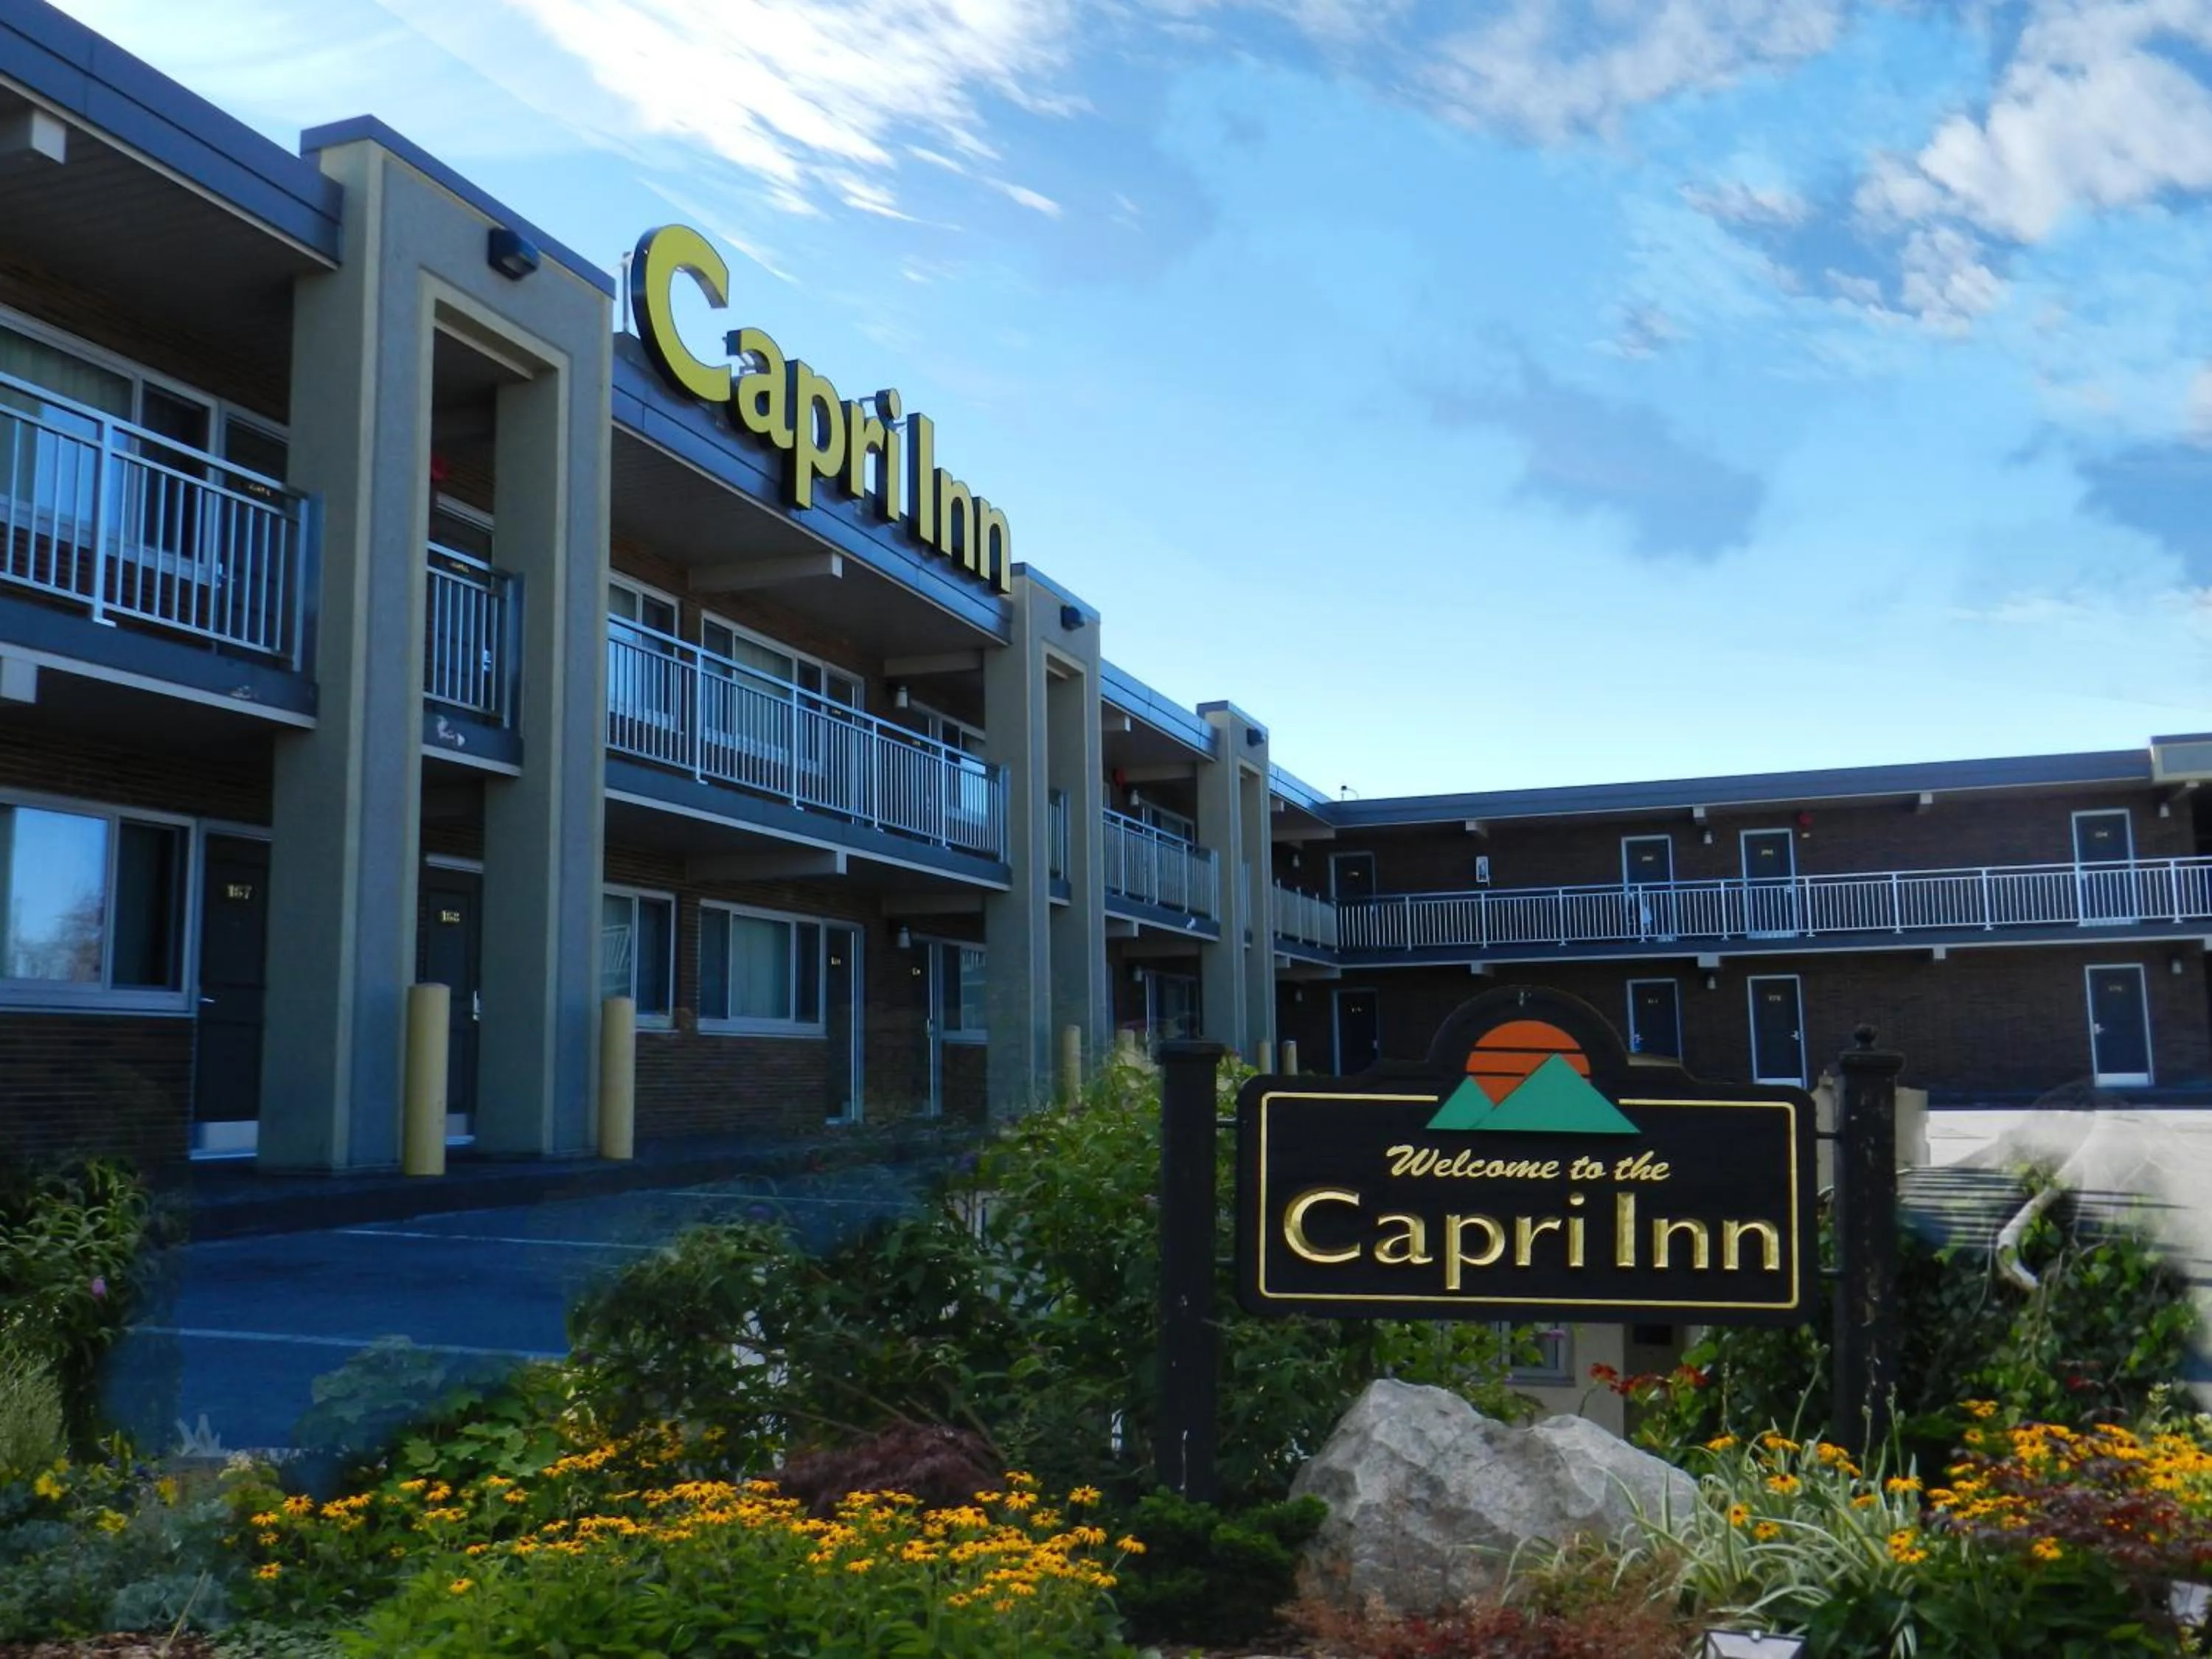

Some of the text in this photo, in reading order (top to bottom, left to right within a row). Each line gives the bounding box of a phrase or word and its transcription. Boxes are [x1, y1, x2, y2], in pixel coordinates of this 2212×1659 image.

[632, 224, 1011, 594] Capri Inn
[1385, 1144, 1671, 1180] Welcome to the
[1284, 1187, 1781, 1290] Capri Inn
